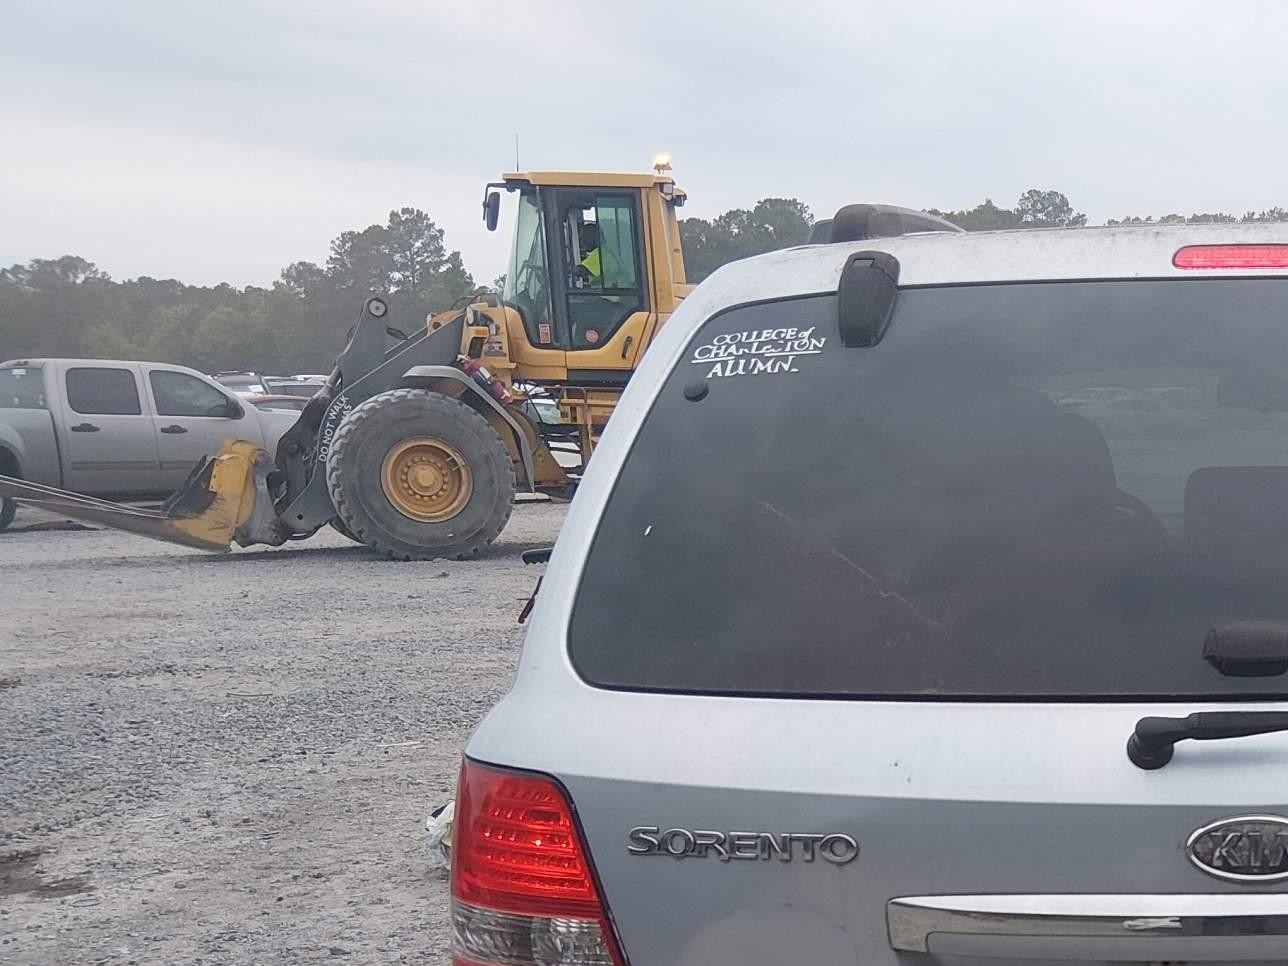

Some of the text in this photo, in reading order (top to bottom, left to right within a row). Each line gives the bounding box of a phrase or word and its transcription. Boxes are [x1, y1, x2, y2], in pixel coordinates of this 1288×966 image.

[713, 326, 815, 346] COLLEGE of
[706, 355, 799, 378] ALUMN
[318, 394, 350, 462] DO NOT WALK
[627, 825, 859, 865] SORENTO
